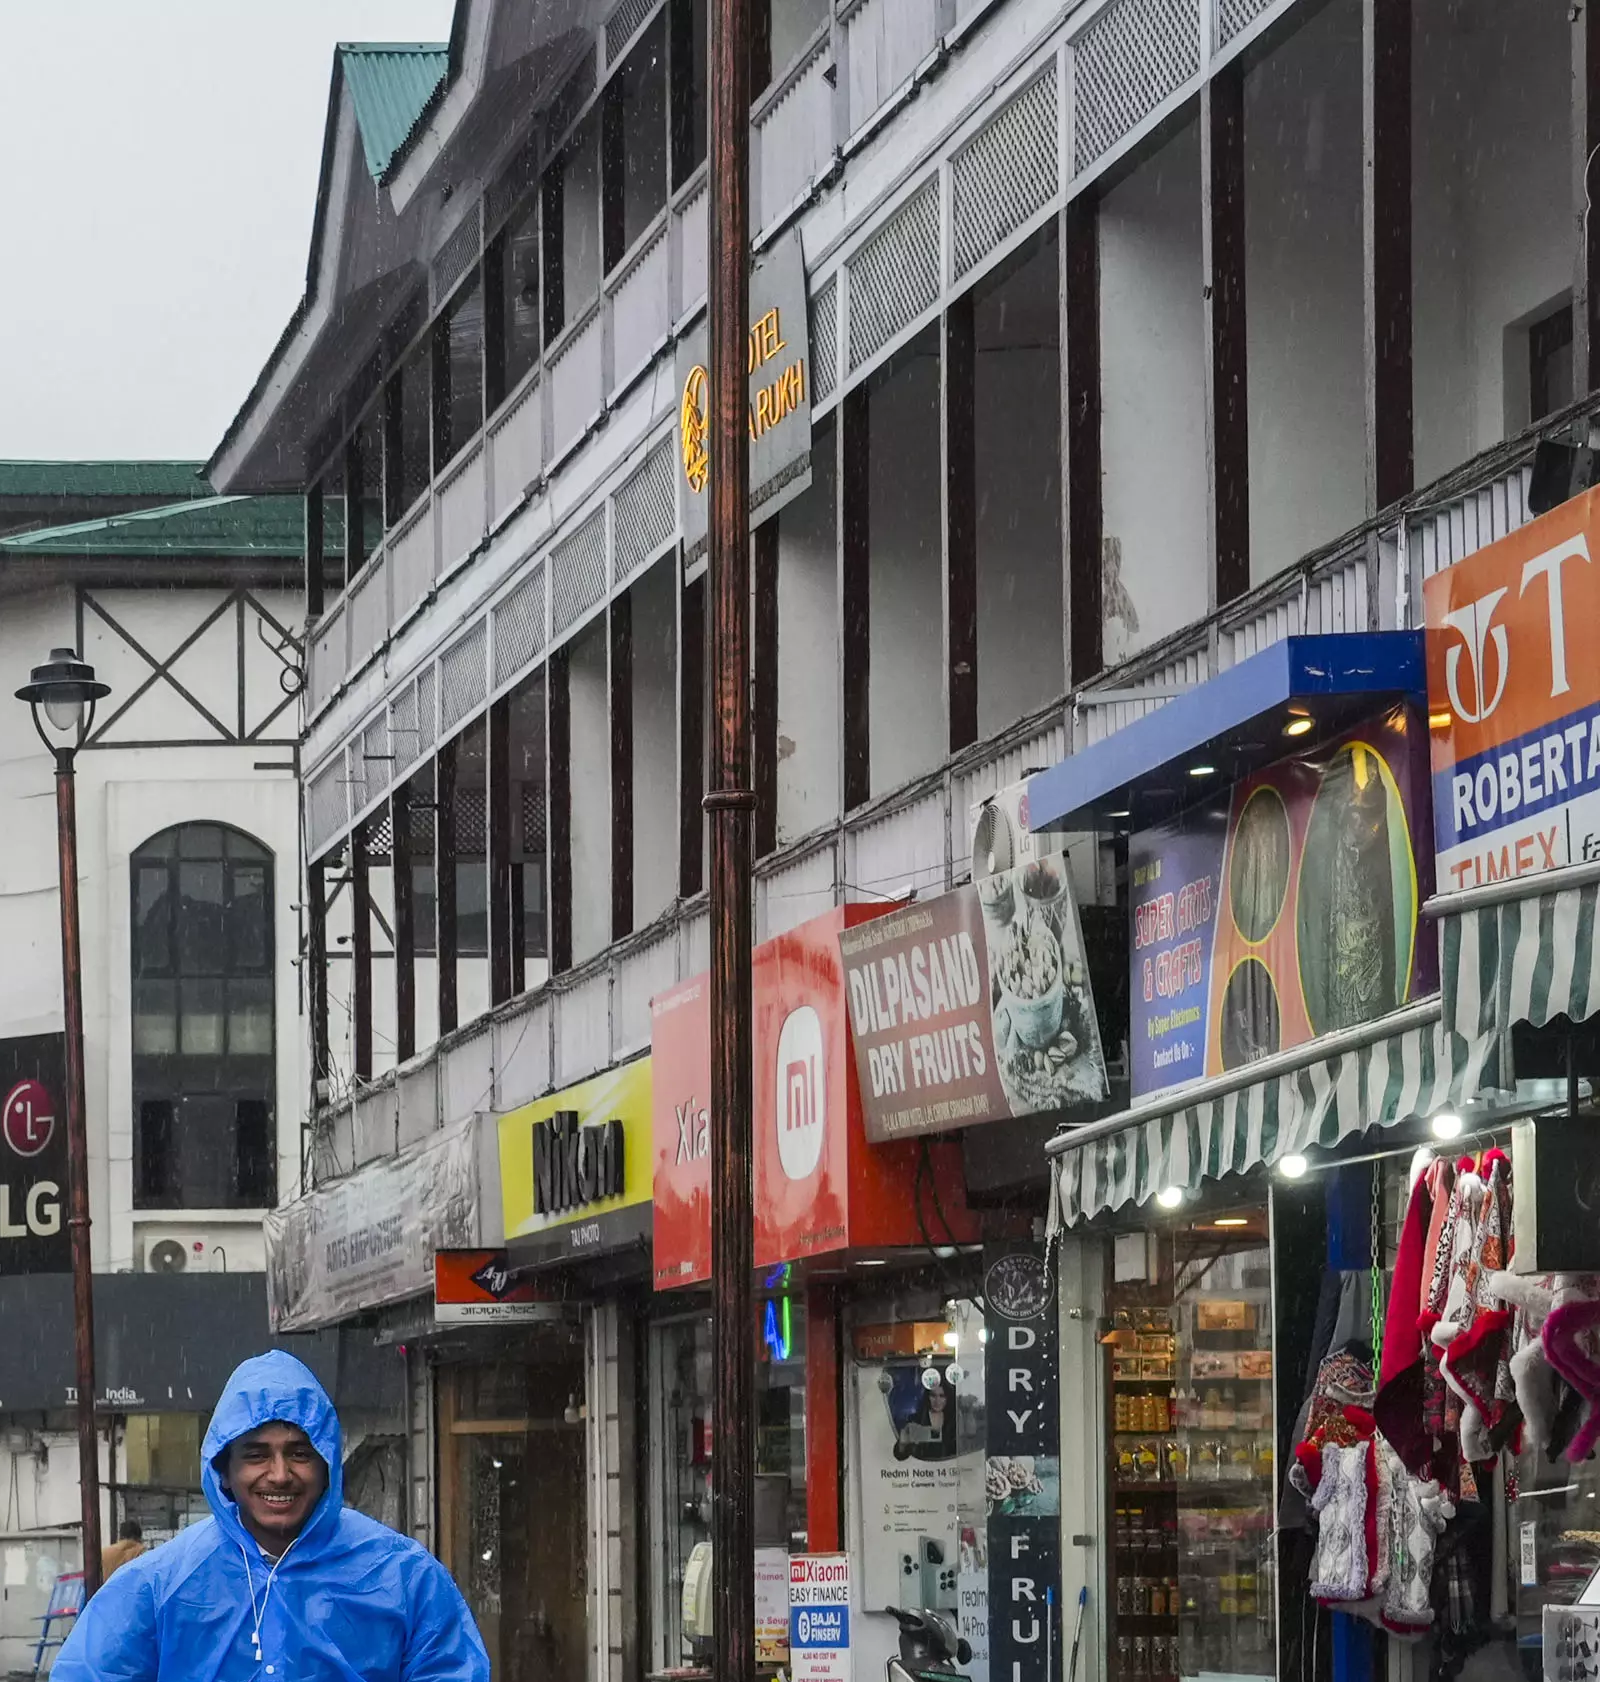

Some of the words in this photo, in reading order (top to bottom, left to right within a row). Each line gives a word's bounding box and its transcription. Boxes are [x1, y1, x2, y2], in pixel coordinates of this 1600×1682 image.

[1135, 891, 1175, 950] SUPER
[1176, 875, 1211, 938] ARTS
[1142, 957, 1154, 1003] &
[1155, 937, 1202, 999] CRAFTS
[848, 931, 981, 1037] DILPASAND
[1155, 1012, 1170, 1037] Super
[868, 1041, 906, 1098] DRY
[909, 1020, 986, 1090] FRUITS
[1153, 1047, 1173, 1069] Contact
[675, 1095, 709, 1166] Xia
[532, 1110, 625, 1216] Nikon
[0, 1180, 61, 1238] LG
[581, 1224, 600, 1245] PHOTO
[106, 1387, 136, 1399] India
[881, 1468, 909, 1479] Redmi
[912, 1468, 934, 1478] Note
[937, 1468, 946, 1477] 14
[806, 1560, 848, 1582] Xiaomi
[790, 1587, 811, 1603] EASY
[812, 1586, 848, 1601] FINANCE
[961, 1586, 989, 1607] realm
[810, 1612, 841, 1626] BAJAJ
[971, 1616, 986, 1637] Pro
[810, 1627, 841, 1642] FINSERV
